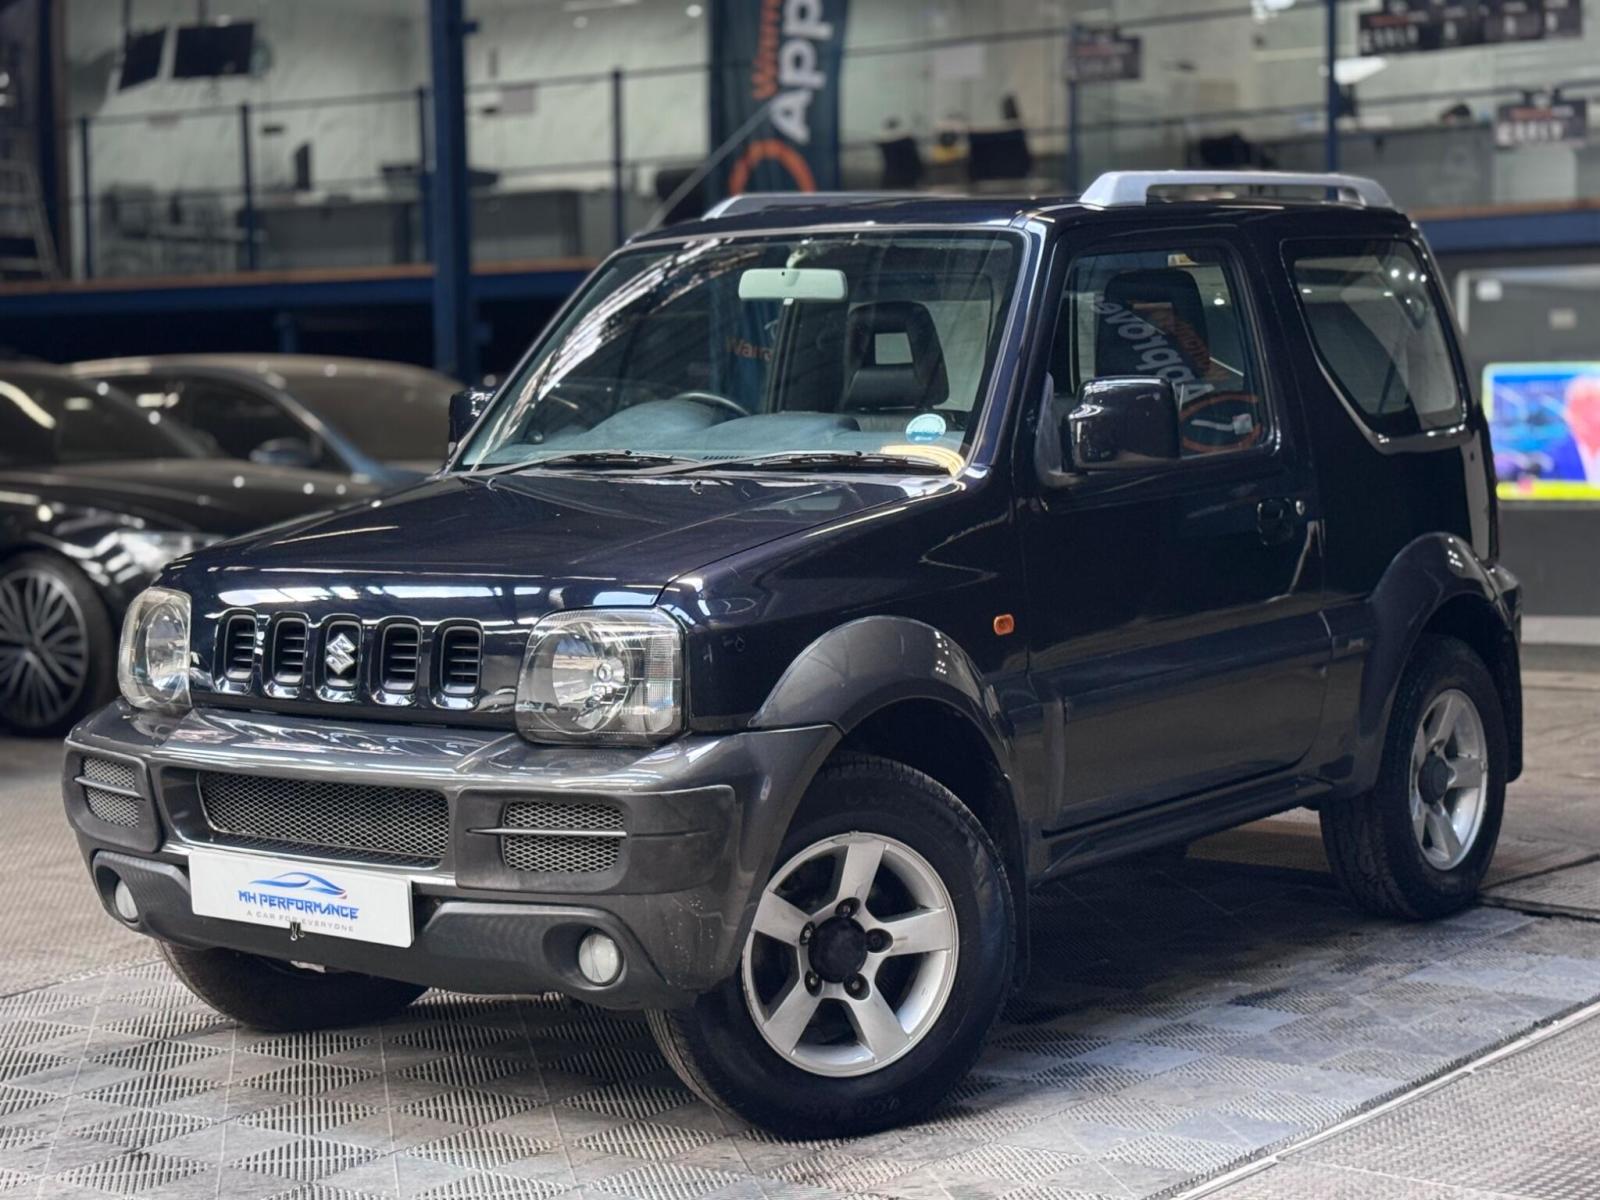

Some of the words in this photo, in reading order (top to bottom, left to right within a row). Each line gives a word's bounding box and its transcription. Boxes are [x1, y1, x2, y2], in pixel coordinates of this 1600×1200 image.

[238, 889, 257, 905] MH
[259, 893, 360, 920] PERFORMANCE
[256, 911, 276, 921] CAR
[280, 914, 297, 923] FOR
[302, 917, 354, 933] EVERYONE
